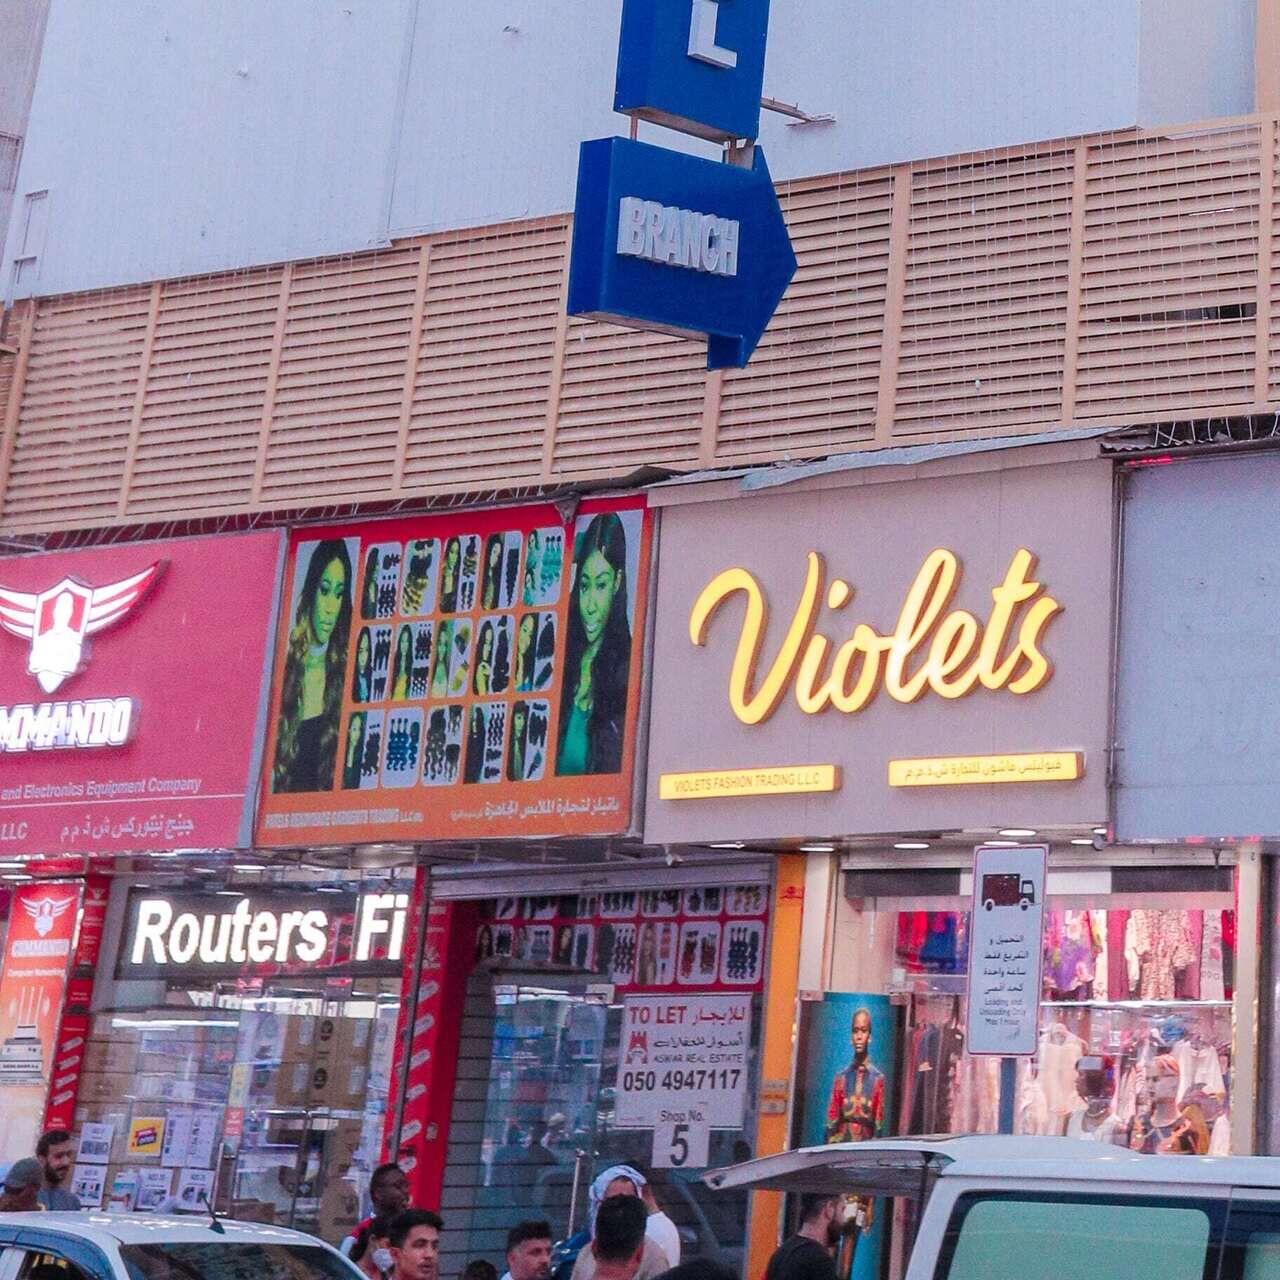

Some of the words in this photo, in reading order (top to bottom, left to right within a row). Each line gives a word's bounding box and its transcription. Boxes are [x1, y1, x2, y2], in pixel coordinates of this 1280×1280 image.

[616, 195, 740, 278] BRANCH
[690, 548, 1066, 725] Violets
[1, 785, 23, 801] and
[23, 782, 84, 800] Electronics
[86, 779, 146, 798] Equipment
[147, 776, 202, 795] Company
[674, 777, 712, 793] VIOLETS
[714, 775, 752, 790] FASHION
[755, 773, 795, 787] TRADING
[131, 898, 328, 964] Routers
[356, 894, 409, 961] Fi
[629, 1005, 650, 1025] TO
[655, 1005, 688, 1024] LET
[653, 1053, 683, 1064] ASWAR
[685, 1053, 706, 1064] REAL
[708, 1053, 743, 1064] ESTATE
[623, 1070, 656, 1092] 050
[661, 1068, 741, 1091] 4947117
[660, 1109, 687, 1123] Shop
[669, 1124, 689, 1167] 5
